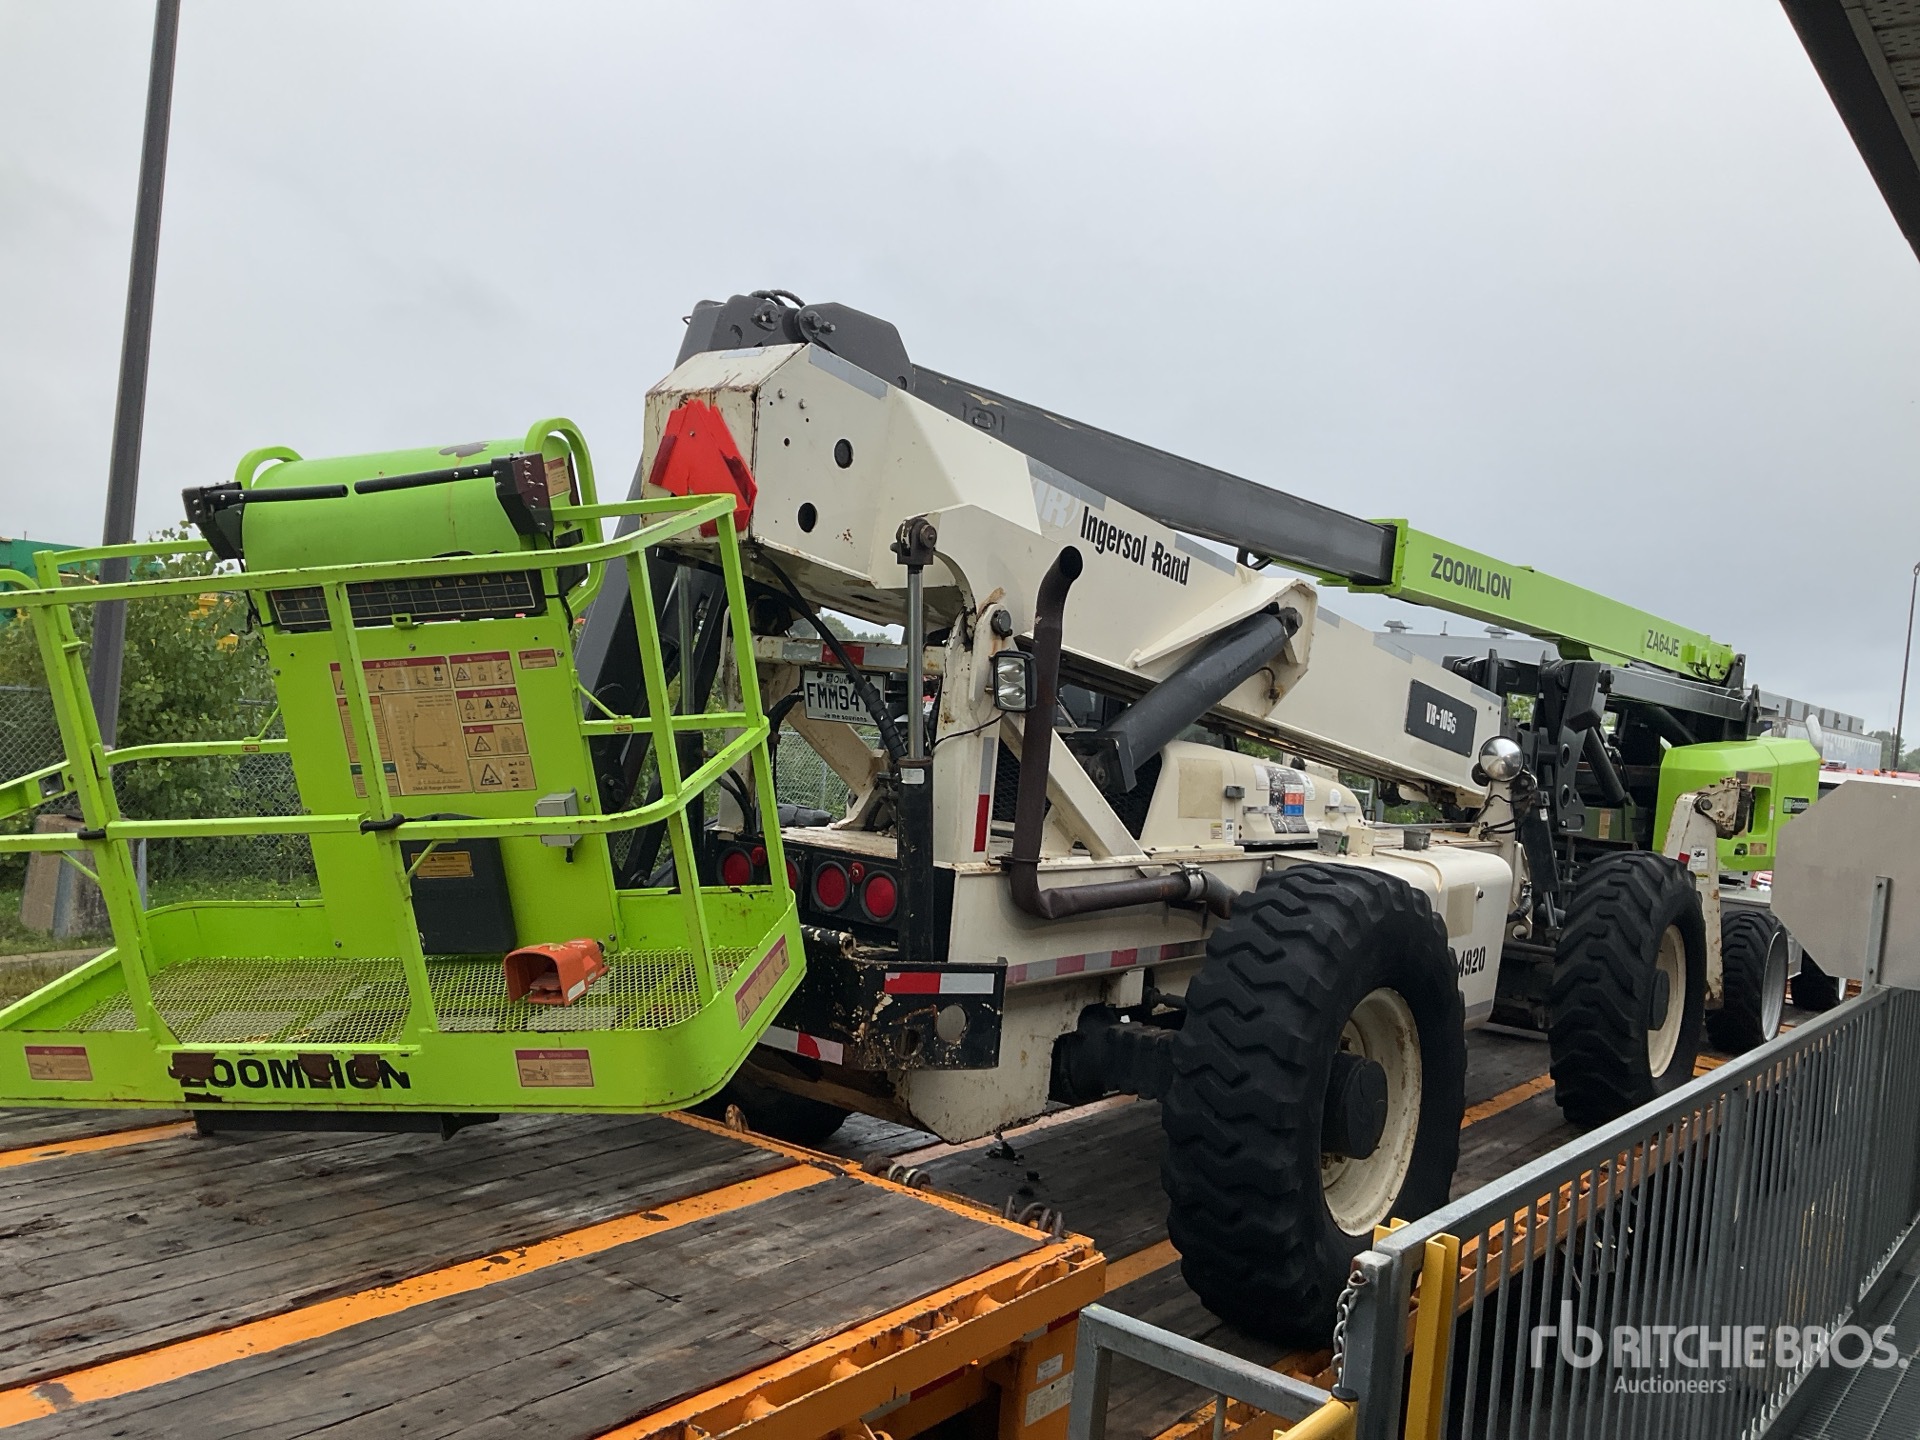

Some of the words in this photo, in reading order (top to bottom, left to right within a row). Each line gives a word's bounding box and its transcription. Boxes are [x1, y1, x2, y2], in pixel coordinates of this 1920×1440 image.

[1080, 505, 1148, 567] Ingersol
[1430, 552, 1512, 601] ZOOMLION
[1646, 629, 1680, 658] ZA64JE
[806, 682, 870, 713] FMM94
